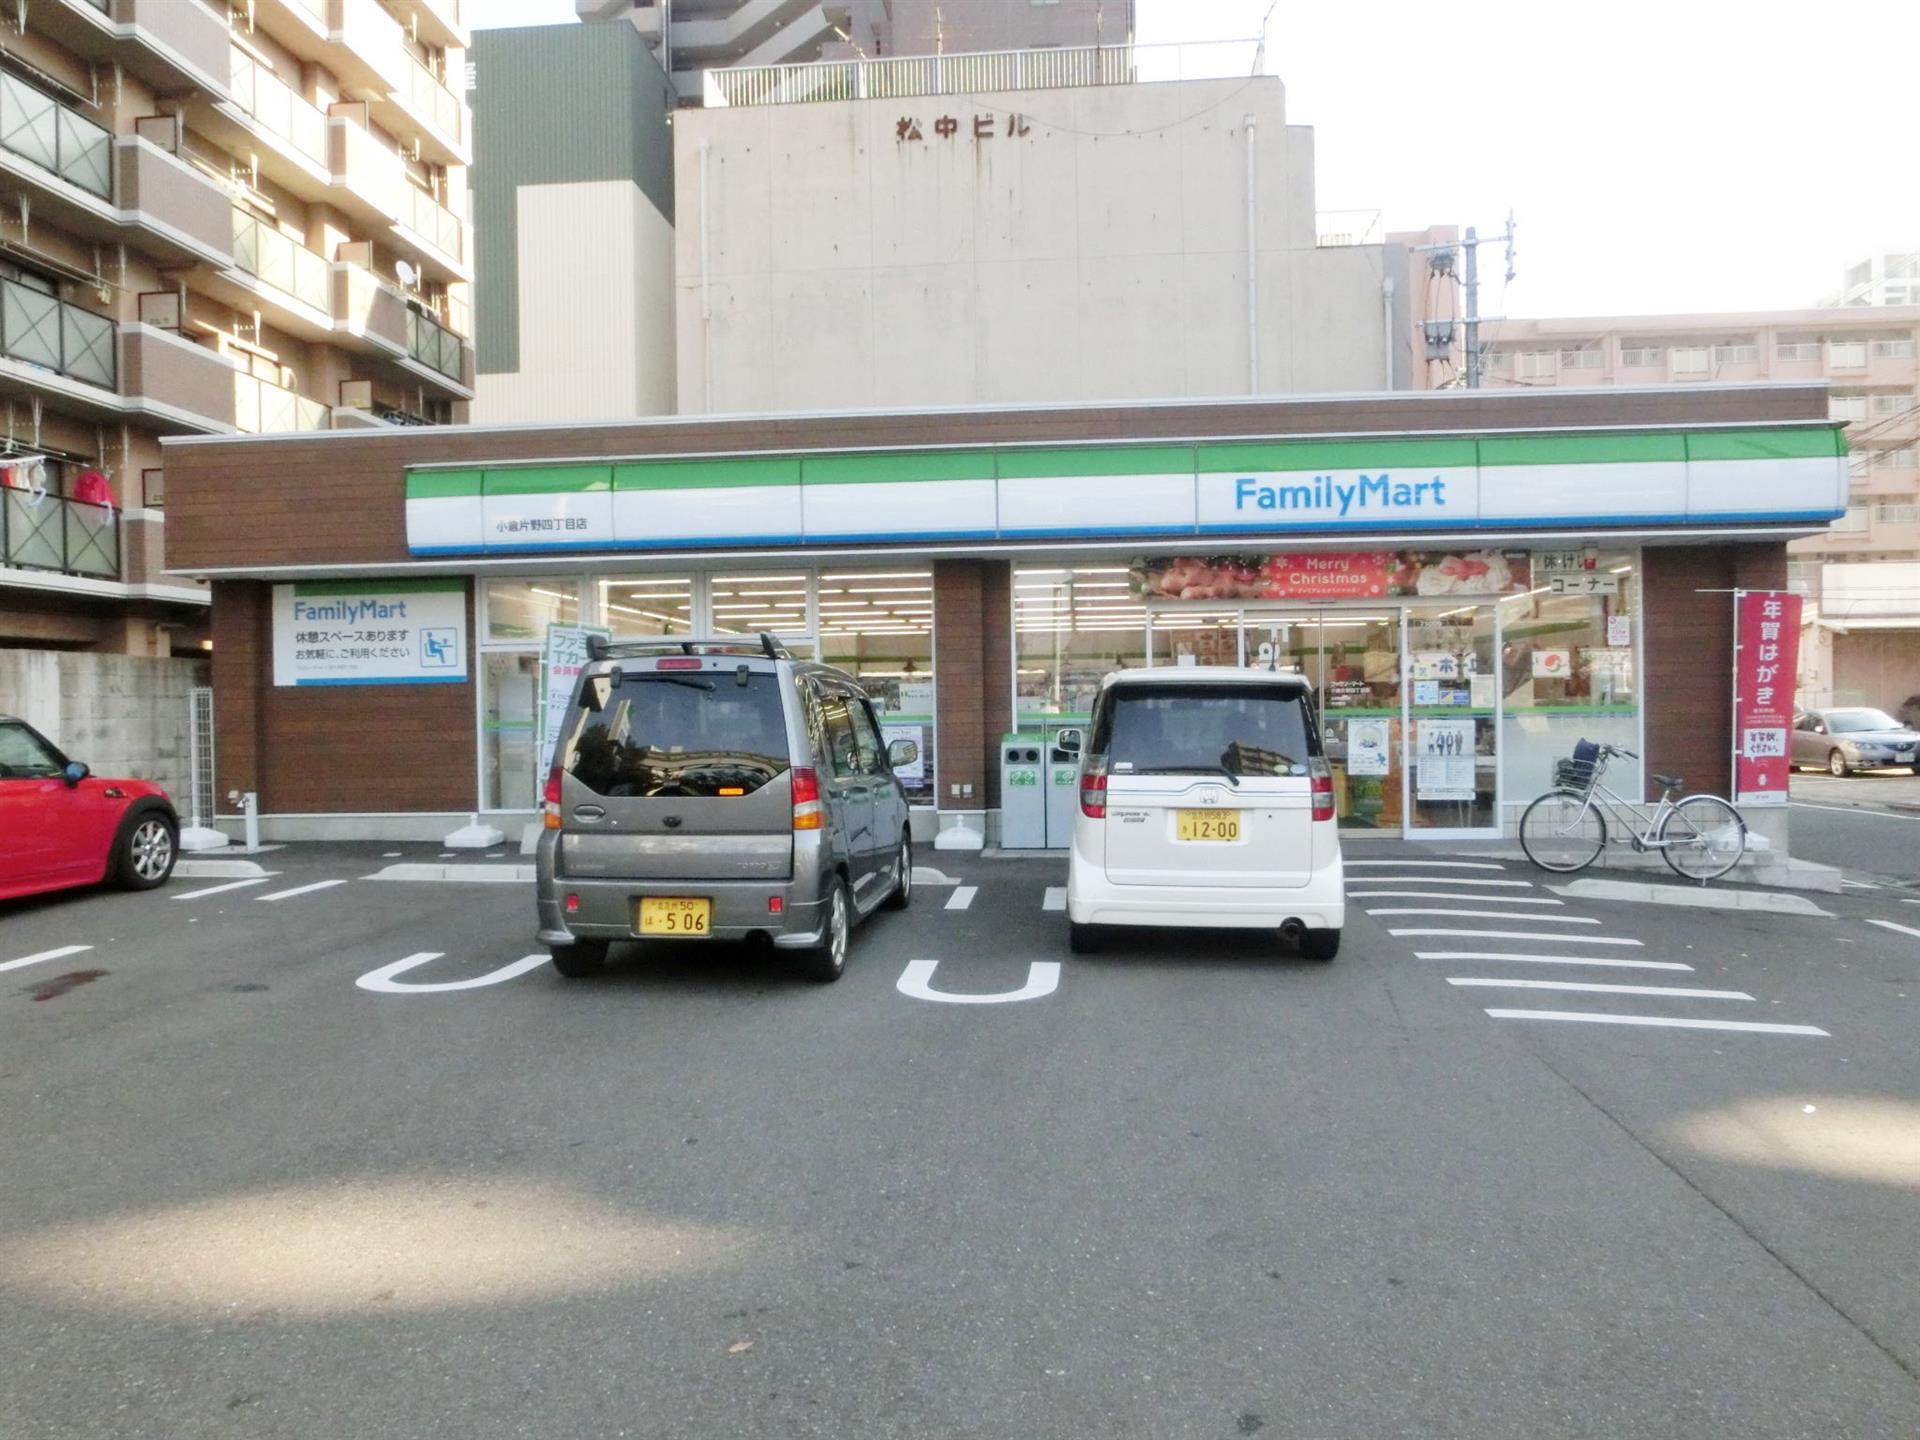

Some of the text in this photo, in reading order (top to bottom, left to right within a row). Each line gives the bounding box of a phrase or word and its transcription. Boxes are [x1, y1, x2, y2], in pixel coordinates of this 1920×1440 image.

[896, 113, 1030, 140] 松中ビル
[1235, 474, 1446, 516] FamilyMart
[1306, 558, 1349, 571] Merry
[1289, 572, 1368, 584] Christmas
[1552, 578, 1615, 592] コーナー
[294, 600, 407, 624] FamilyMart
[295, 630, 409, 644] 休憩スペースあります
[1755, 600, 1782, 705] 年賀はがき
